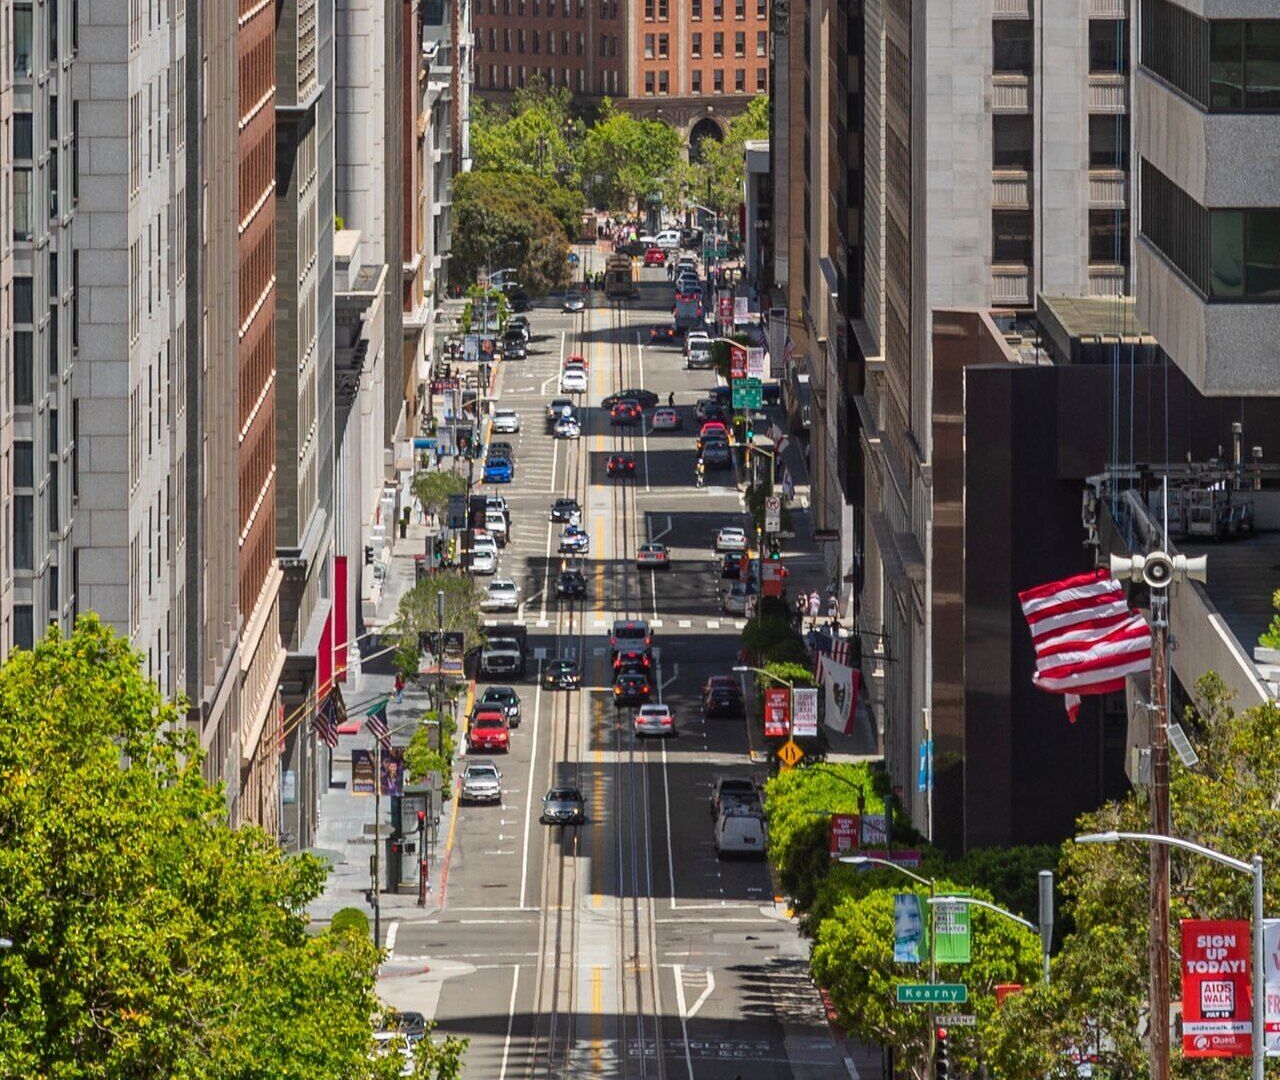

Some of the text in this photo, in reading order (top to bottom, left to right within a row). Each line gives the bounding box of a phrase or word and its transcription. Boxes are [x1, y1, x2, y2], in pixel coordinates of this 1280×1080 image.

[1196, 935, 1236, 948] SIGN
[1206, 948, 1228, 960] UP
[1187, 960, 1246, 973] TODAY!
[1203, 983, 1231, 993] AIDS
[905, 988, 958, 1000] Kearny
[1203, 994, 1232, 1004] WALK
[936, 1016, 975, 1025] KEARNY
[1212, 1035, 1236, 1045] Quest
